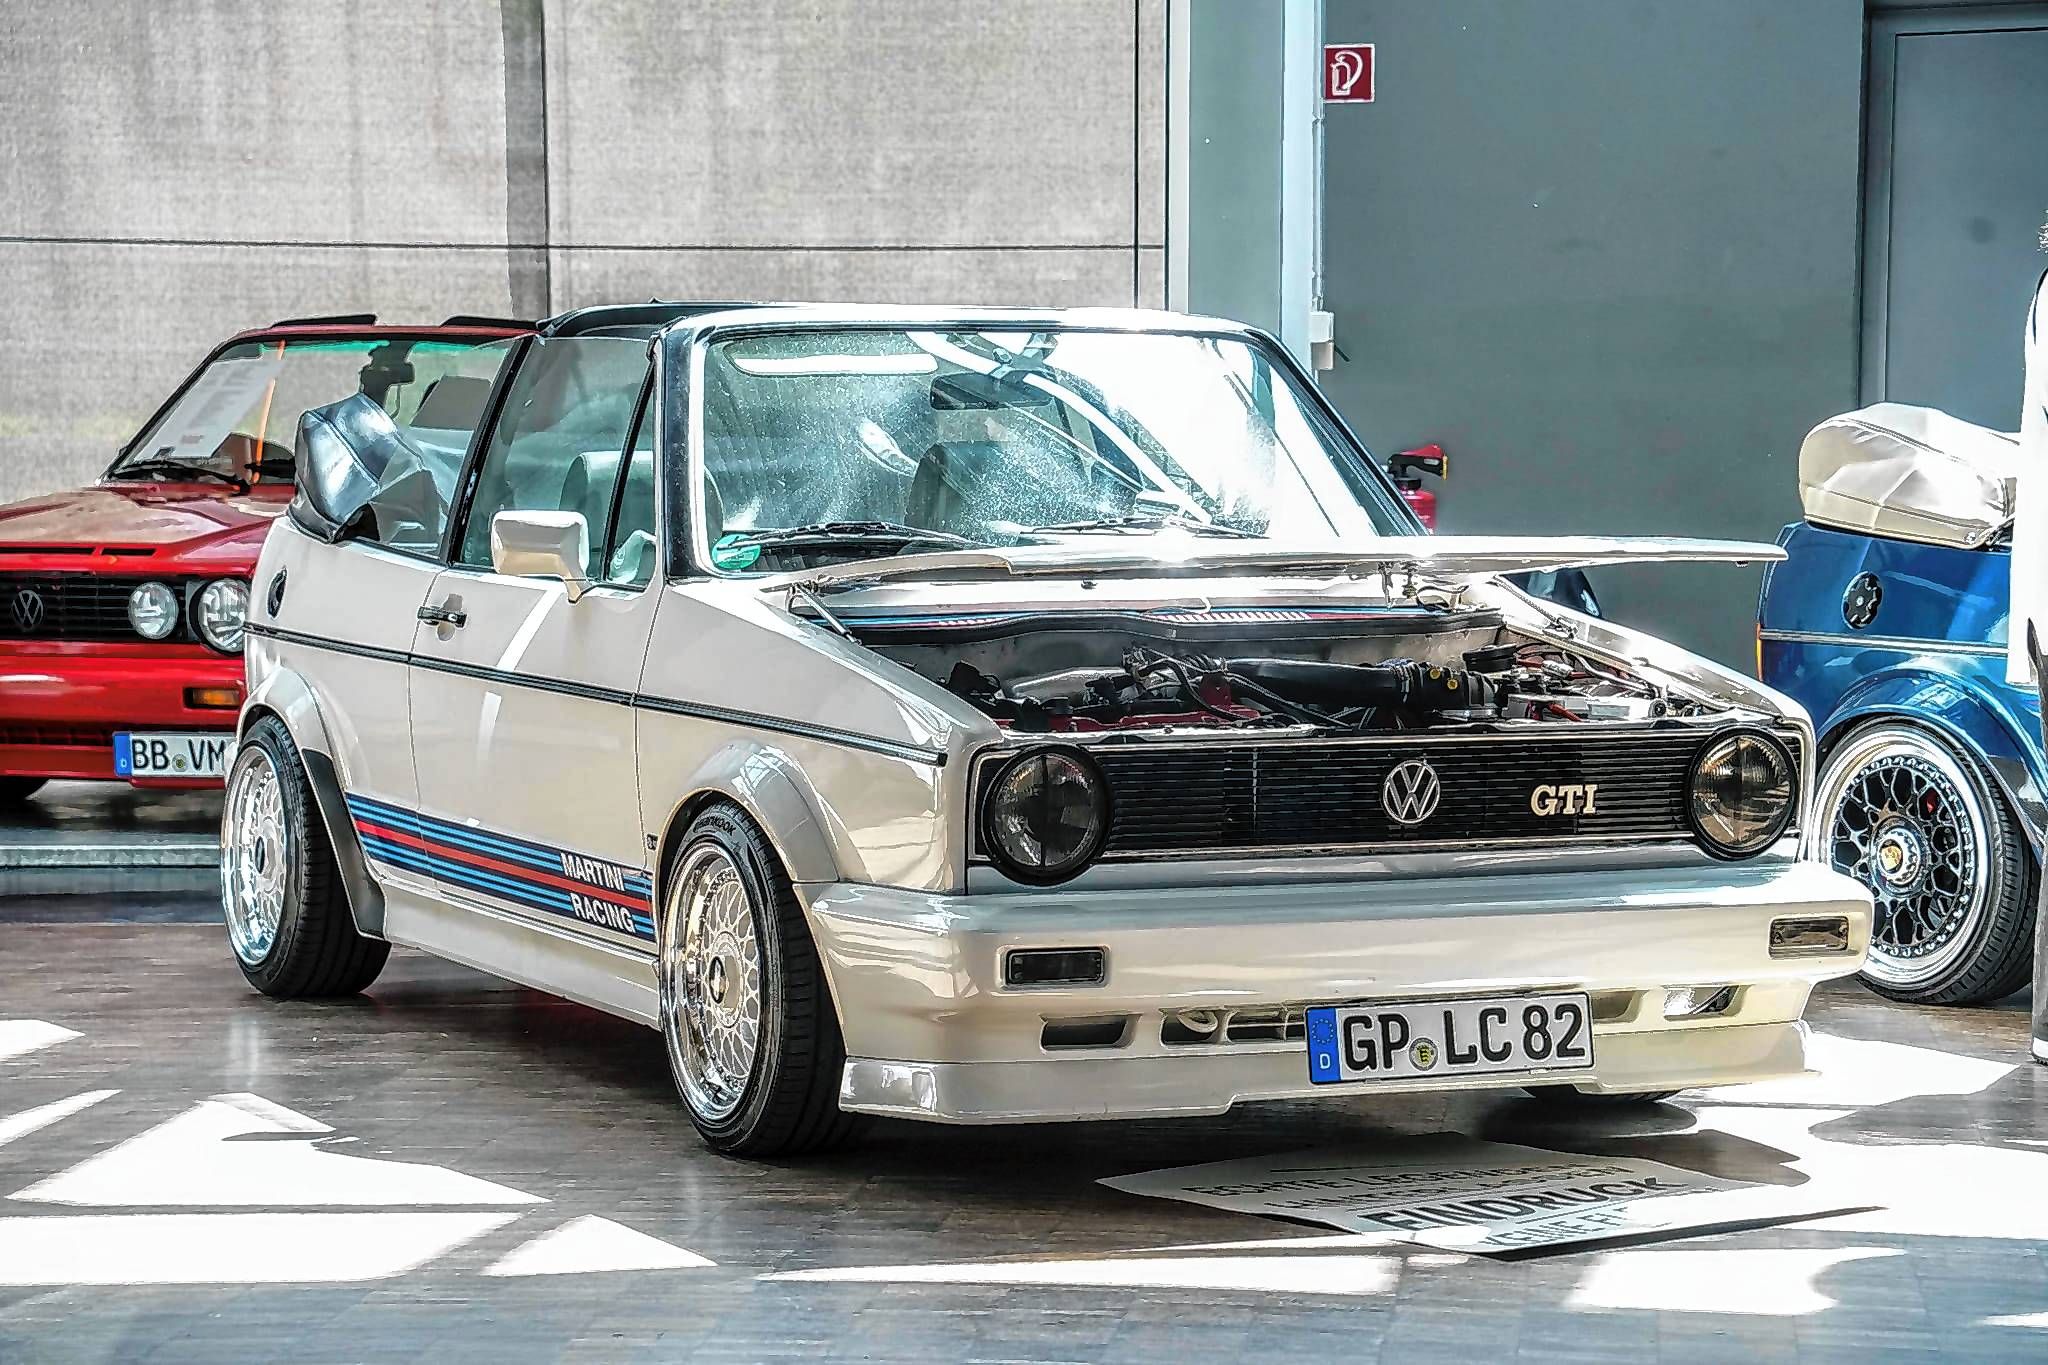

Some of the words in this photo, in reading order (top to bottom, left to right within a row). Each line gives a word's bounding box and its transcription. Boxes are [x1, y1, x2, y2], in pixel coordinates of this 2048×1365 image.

[131, 738, 169, 770] BB
[188, 738, 226, 772] VM
[1383, 759, 1440, 824] VW
[1530, 784, 1598, 816] GTI
[560, 852, 625, 891] MARTINI
[570, 892, 636, 933] RACING
[1319, 1052, 1331, 1069] D
[1342, 1012, 1411, 1071] GP
[1443, 1005, 1513, 1066] LC
[1522, 1002, 1586, 1060] 82
[1357, 1176, 1689, 1231] EINDRUCK
[1478, 1220, 1606, 1247] KEINE
